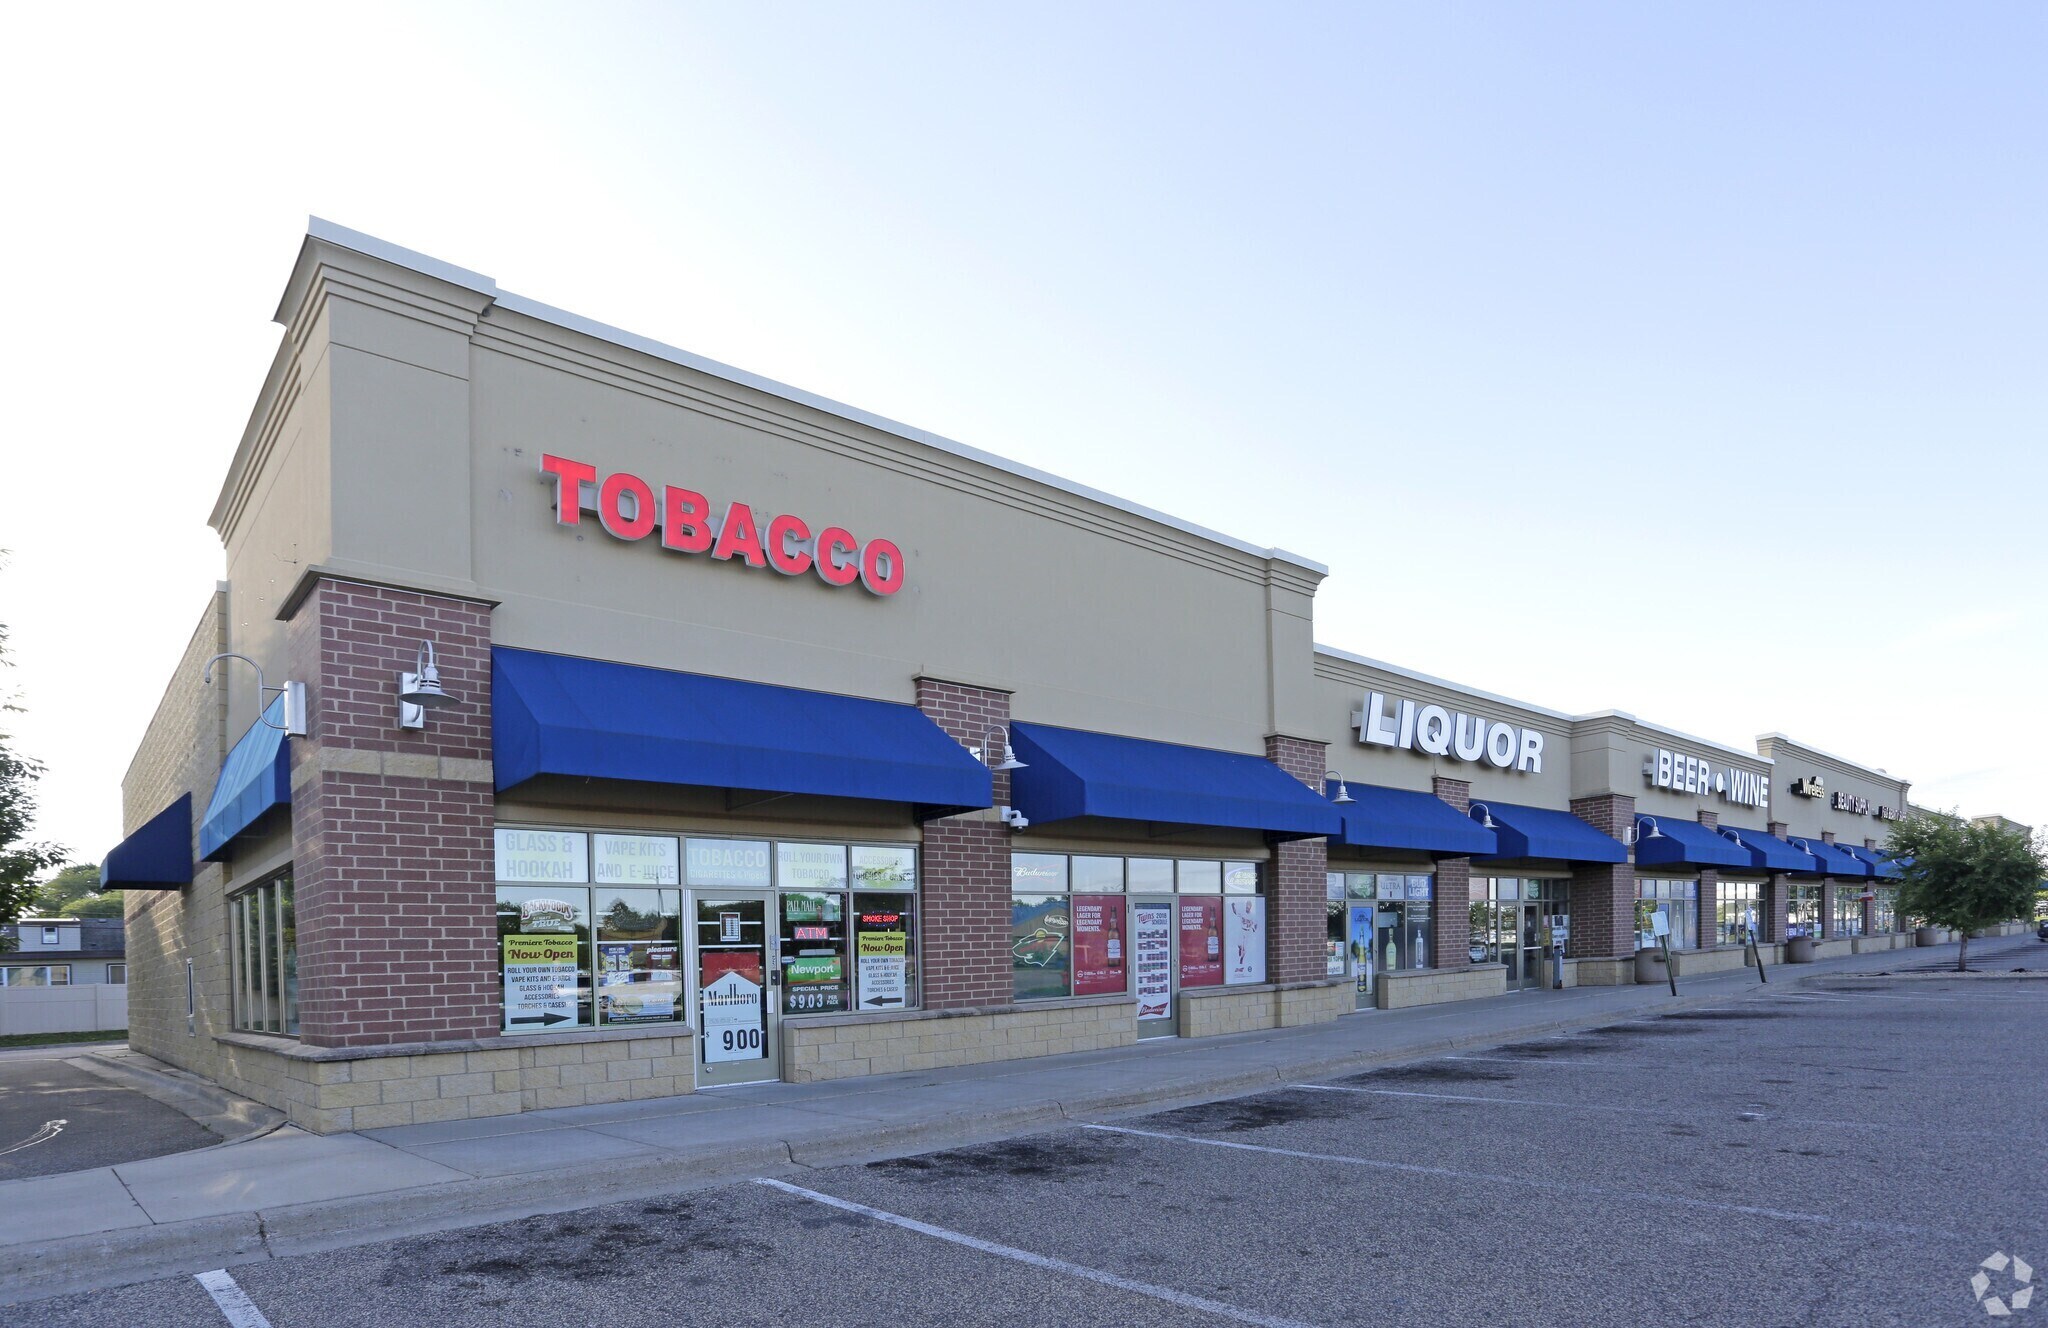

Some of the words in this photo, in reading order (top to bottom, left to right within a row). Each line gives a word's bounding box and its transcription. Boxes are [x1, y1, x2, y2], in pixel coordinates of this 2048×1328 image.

[539, 453, 905, 596] TOBACCO
[1360, 692, 1544, 774] LIQUOR
[1652, 749, 1710, 795] BEER
[1726, 768, 1768, 808] WINE
[1799, 778, 1824, 798] Wireless
[1836, 792, 1854, 812] BEAUTY
[1856, 796, 1870, 815] SUPPLY
[506, 833, 556, 852] GLASS
[563, 836, 572, 852] &
[605, 840, 636, 855] VAPE
[640, 842, 666, 856] KITS
[688, 848, 766, 867] TOBACCO
[779, 851, 797, 863] ROLL
[800, 852, 820, 863] YOUR
[824, 853, 843, 864] OWN
[506, 860, 573, 878] HOOKAH
[598, 863, 622, 878] AND
[629, 864, 674, 879] E-JUICE
[690, 869, 736, 879] CIGARETTES
[792, 868, 830, 880] TOBACCO
[1014, 867, 1058, 877] Budweiser
[1412, 879, 1427, 887] BUD
[1408, 888, 1429, 897] LIGHT
[521, 899, 573, 920] BACKWOODS
[786, 900, 799, 912] PALL
[801, 900, 815, 912] MALL
[532, 919, 560, 928] TRUE
[1137, 912, 1154, 924] Twins
[796, 927, 827, 939] ATM
[508, 949, 542, 959] Now
[544, 949, 574, 961] Open
[884, 944, 903, 953] Open
[791, 965, 834, 974] Newport
[708, 984, 757, 1006] Marlboro
[790, 994, 823, 1008] $9.03
[723, 1028, 759, 1051] 9.00
